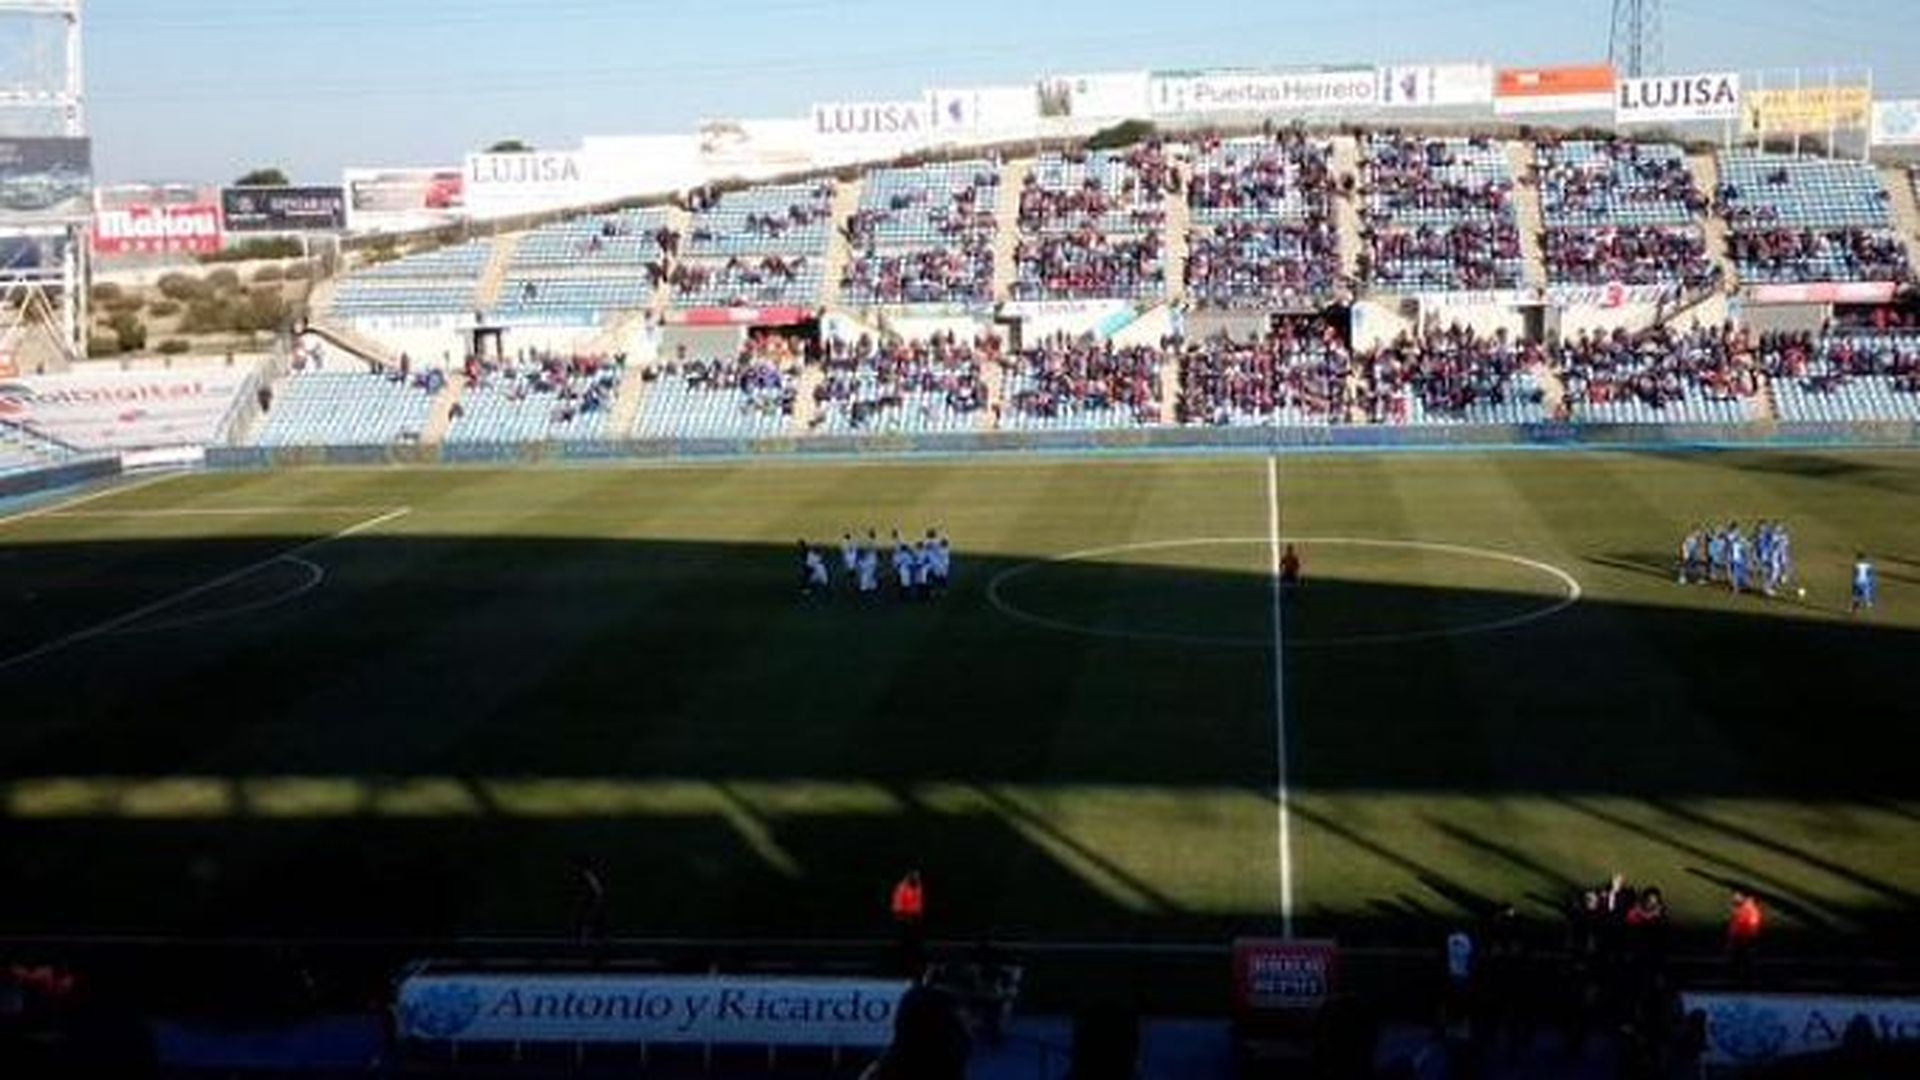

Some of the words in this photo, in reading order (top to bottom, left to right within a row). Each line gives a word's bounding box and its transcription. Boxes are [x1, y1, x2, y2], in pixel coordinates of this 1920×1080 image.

[1621, 77, 1736, 109] LUJISA
[816, 106, 920, 134] LUJISA
[472, 155, 580, 184] LUJISA
[491, 986, 675, 1021] Antonio
[677, 996, 708, 1031] y
[715, 989, 891, 1023] Ricardo
